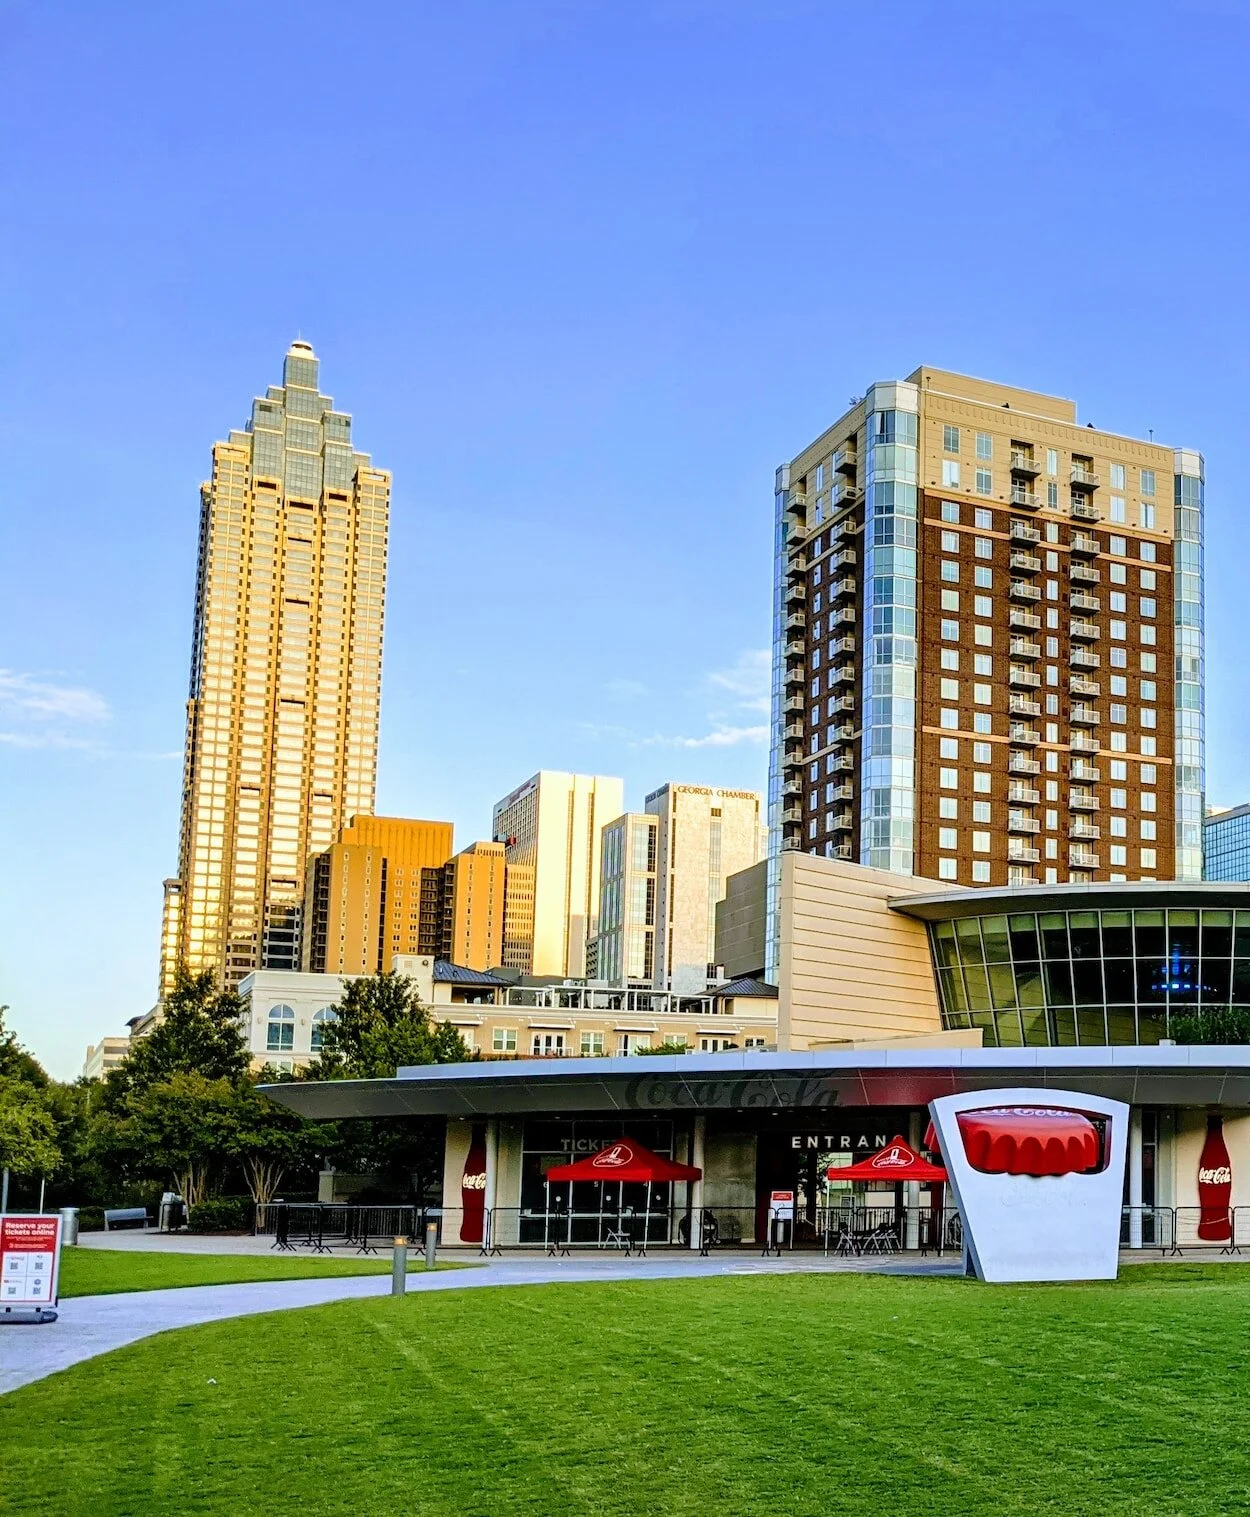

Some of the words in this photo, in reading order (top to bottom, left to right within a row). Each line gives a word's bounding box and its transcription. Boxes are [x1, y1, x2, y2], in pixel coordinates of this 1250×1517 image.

[677, 785, 714, 796] GEORGIA
[716, 790, 755, 800] CHAMBER
[792, 1135, 886, 1148] ENTRAN
